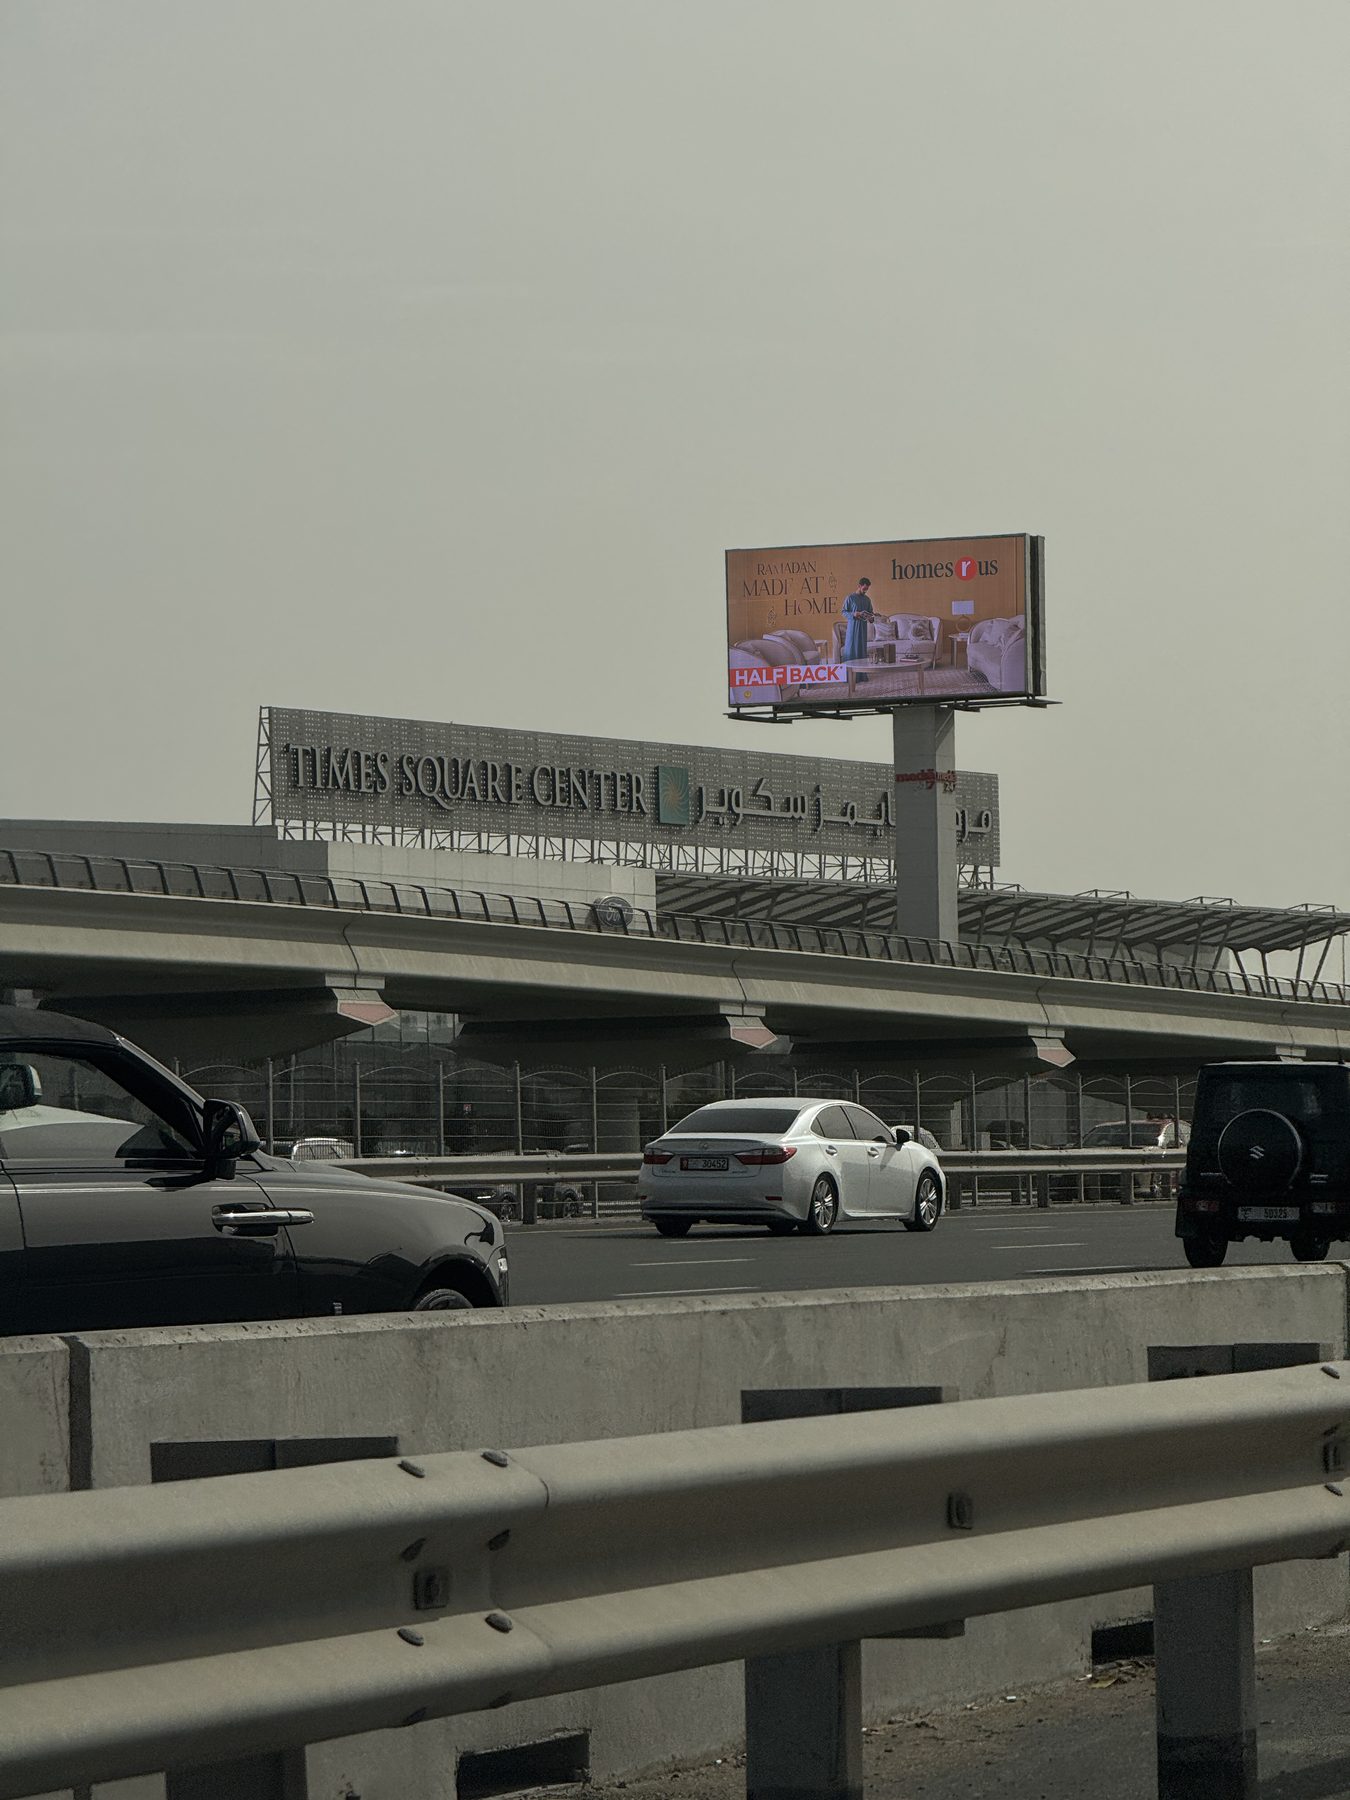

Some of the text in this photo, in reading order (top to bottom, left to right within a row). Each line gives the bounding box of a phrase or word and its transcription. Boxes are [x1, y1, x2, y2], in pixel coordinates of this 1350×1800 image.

[757, 561, 817, 576] RAMADAN
[891, 559, 954, 580] homes
[978, 560, 999, 576] us
[800, 576, 825, 594] AT
[784, 597, 838, 616] HOME
[735, 668, 785, 685] HALF
[287, 743, 650, 814] TIMES SQUARE CENTER
[698, 778, 808, 827] سكوير
[815, 784, 896, 837] ايمز
[703, 1159, 727, 1169] 30452
